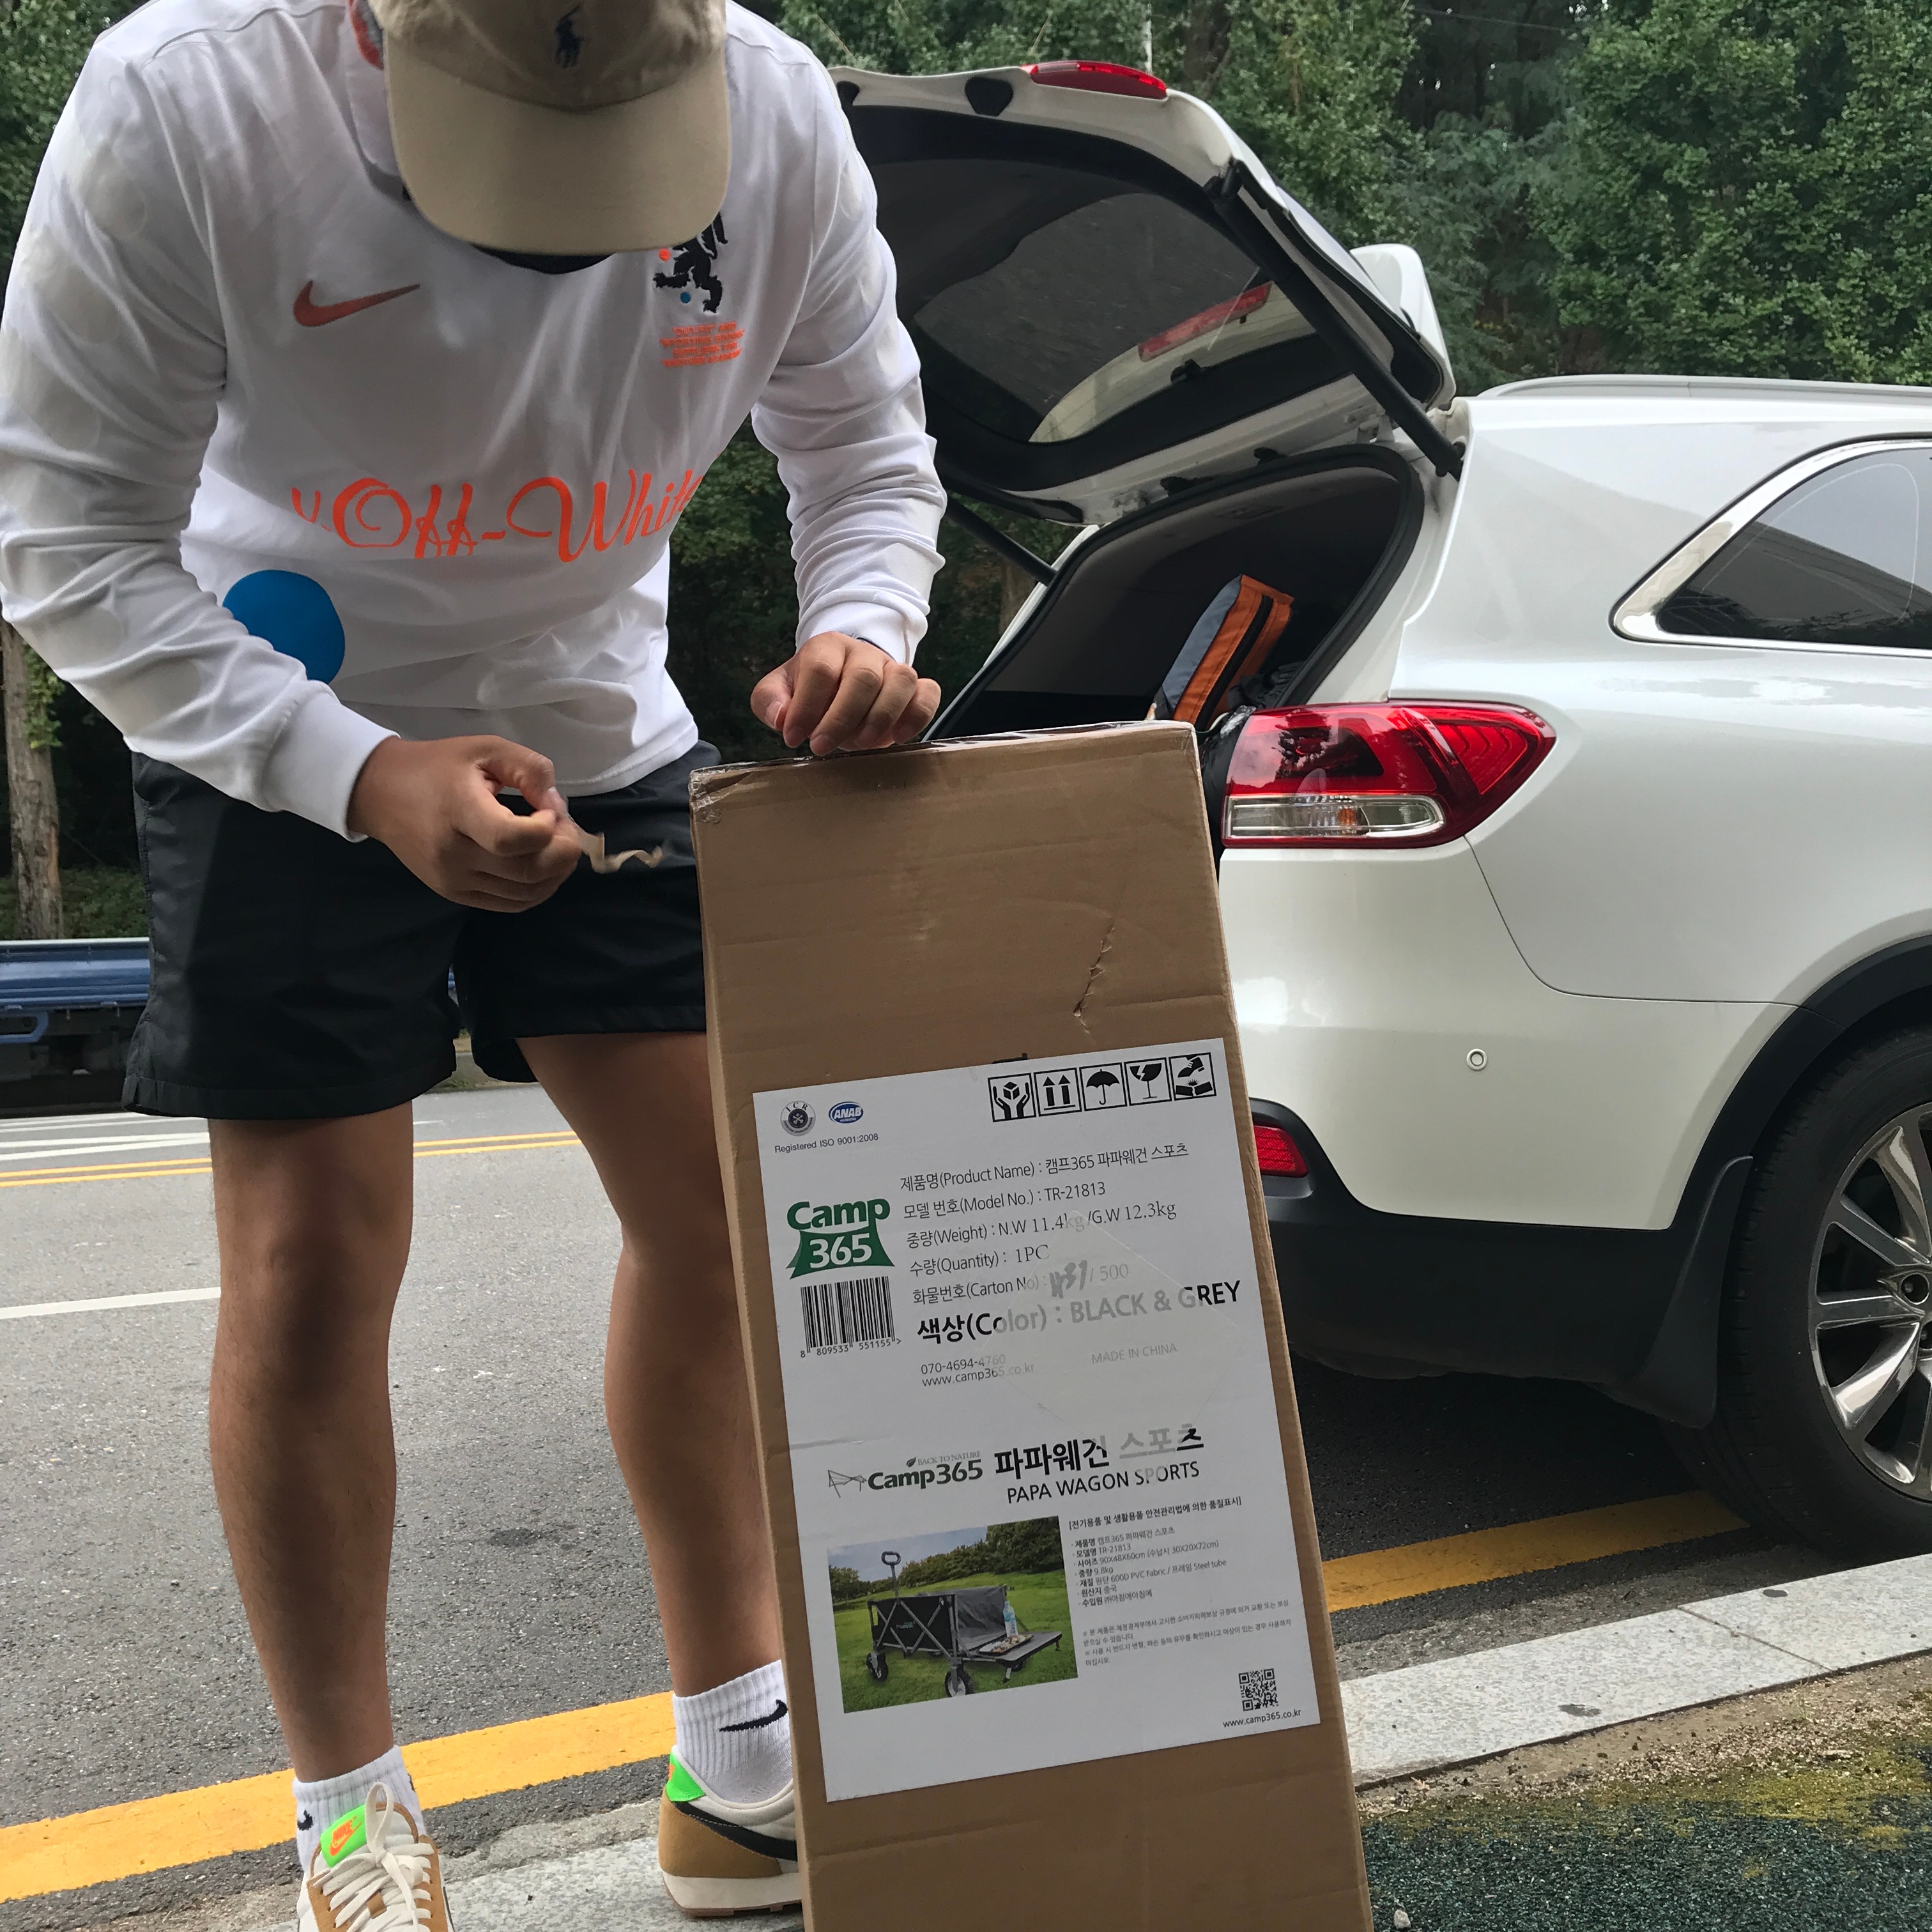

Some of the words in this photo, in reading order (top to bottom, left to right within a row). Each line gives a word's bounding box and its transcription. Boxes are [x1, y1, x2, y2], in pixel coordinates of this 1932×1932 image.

[786, 1101, 808, 1112] ICR
[834, 1107, 862, 1119] ANAB
[774, 1141, 816, 1153] Registered
[820, 1138, 834, 1147] ISO
[837, 1133, 878, 1145] 9001:2008
[900, 1169, 991, 1192] 제품명(Product
[994, 1161, 1034, 1179] Name)
[1045, 1155, 1094, 1174] 캠프365
[1097, 1147, 1147, 1167] 파파웨건
[1151, 1143, 1189, 1160] 스포츠
[904, 1202, 930, 1219] 모델
[933, 1193, 1004, 1216] 번호(Model
[1008, 1190, 1034, 1206] No.)
[1044, 1182, 1105, 1201] TR-21813
[786, 1199, 891, 1230] Camp
[907, 1223, 987, 1248] 중량(Weight)
[999, 1220, 1026, 1236] N.W
[1032, 1213, 1084, 1232] 11.4kg
[1125, 1201, 1177, 1220] 12.3kg
[809, 1232, 872, 1268] 365
[910, 1251, 999, 1276] 수량(Quantity)
[1016, 1245, 1049, 1262] 1PC
[913, 1282, 1013, 1305] 화물번호(Carton
[1016, 1275, 1039, 1291] No)
[1100, 1263, 1129, 1281] 500
[917, 1304, 1046, 1344] 색상(Color)
[1070, 1292, 1147, 1323] BLACK
[1154, 1289, 1172, 1311] &
[1178, 1280, 1241, 1308] GREY
[816, 1344, 849, 1356] 809533
[859, 1340, 891, 1350] 551155
[1091, 1349, 1124, 1364] MADE
[1129, 1348, 1139, 1359] IN
[1142, 1343, 1177, 1356] CHINA
[921, 1354, 1006, 1374] 070-4694-4760
[922, 1363, 1034, 1386] www.camp365.co.kr
[868, 1459, 983, 1490] Camp365
[994, 1435, 1109, 1480] 파파웨건
[1119, 1423, 1204, 1459] 스포츠
[917, 1456, 938, 1466] BACK
[939, 1455, 950, 1463] TO
[951, 1451, 981, 1461] NATURE
[1007, 1483, 1052, 1503] PAPA
[1055, 1471, 1129, 1496] WAGON
[1134, 1460, 1199, 1485] SPORTS
[1103, 1515, 1112, 1524] 및
[1114, 1510, 1144, 1524] 생활용품
[1146, 1504, 1190, 1519] 안전관리법에
[1192, 1501, 1207, 1512] 의한
[1075, 1537, 1096, 1549] 제품명
[1098, 1544, 1131, 1554] TR-21813
[1078, 1558, 1098, 1568] 사이즈
[1131, 1570, 1145, 1579] PVC
[1146, 1568, 1166, 1577] Fabric
[1193, 1561, 1210, 1570] Steel
[1211, 1560, 1226, 1568] tube
[1223, 1709, 1301, 1728] www.camp365.co.kr
